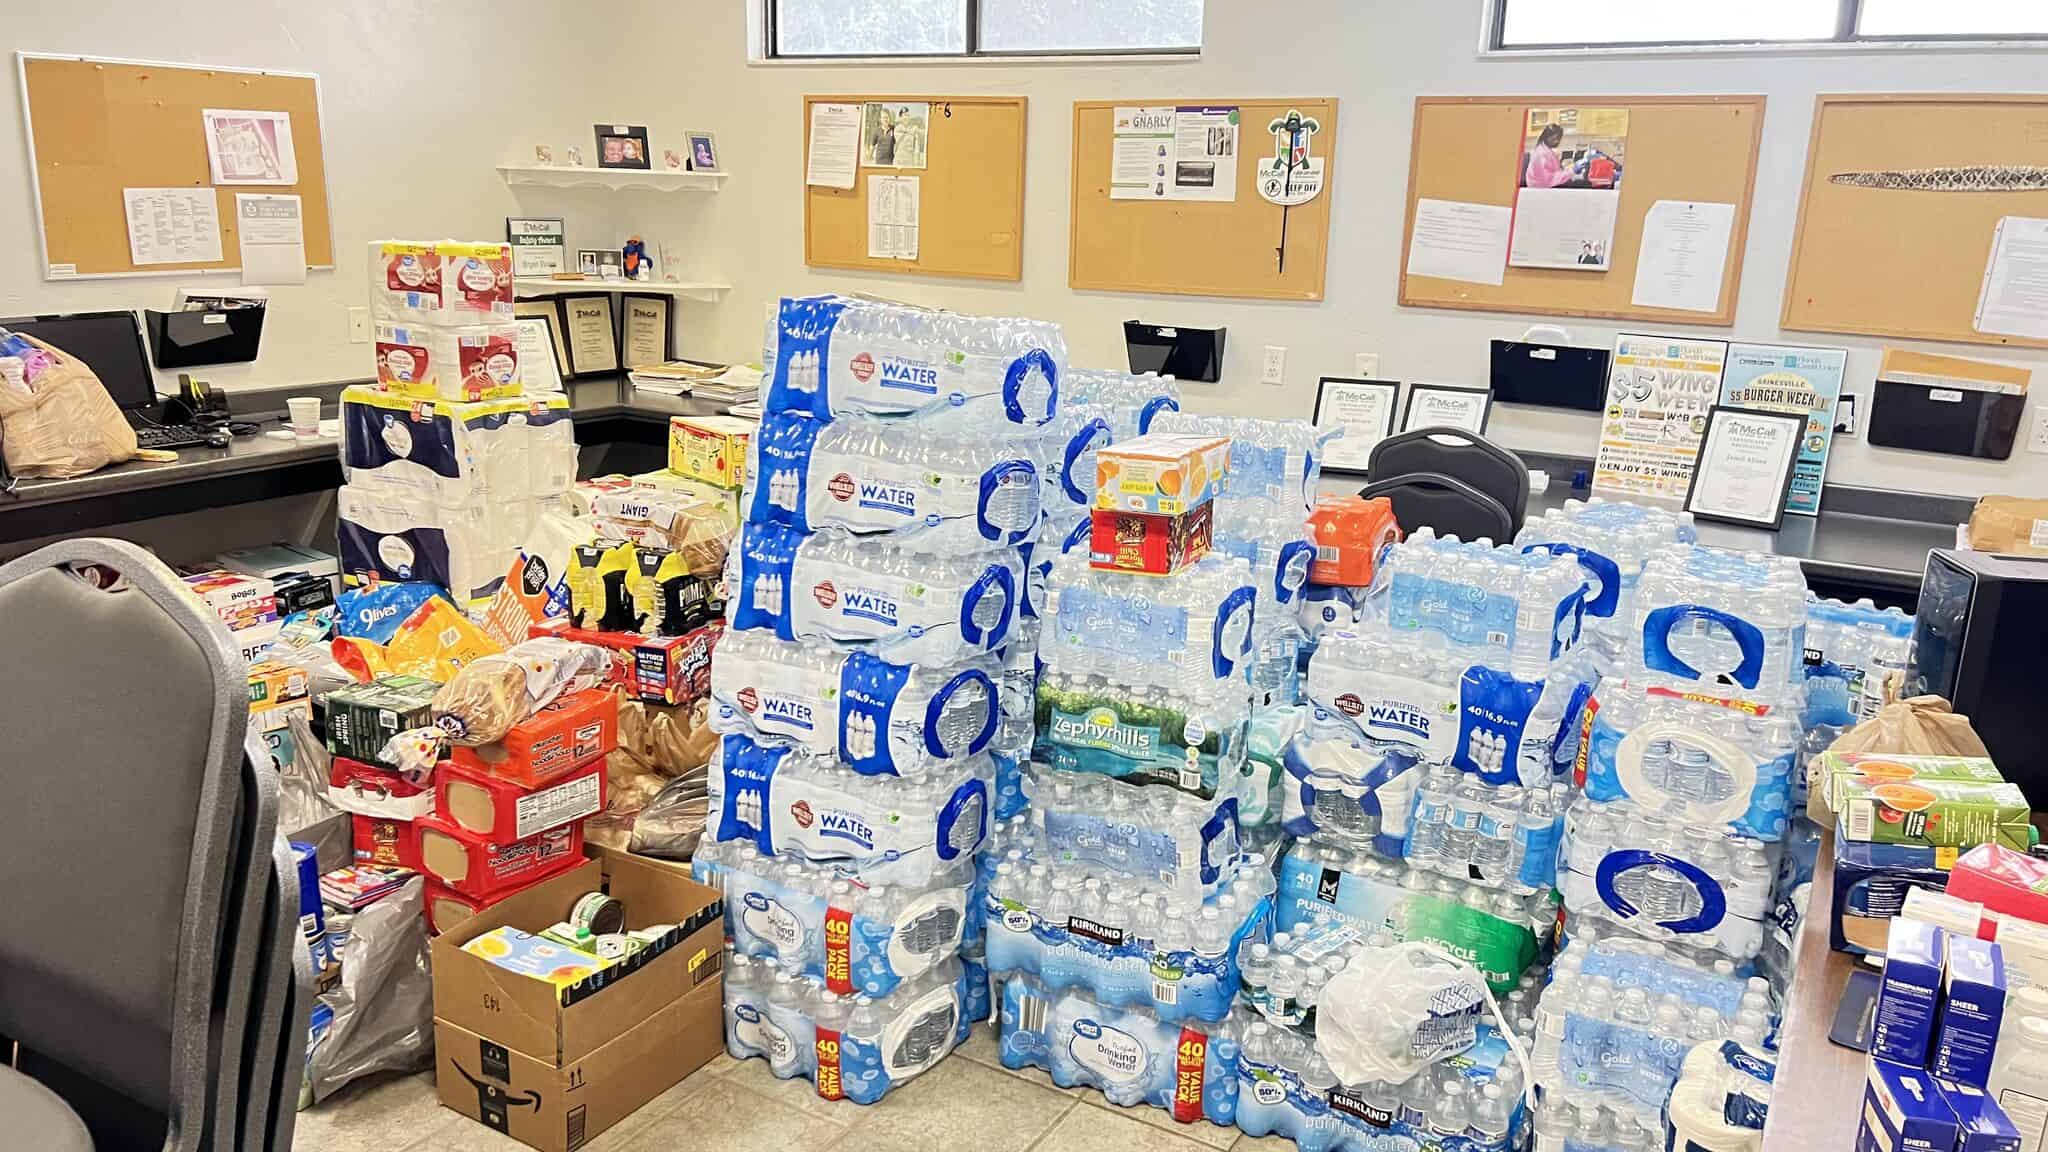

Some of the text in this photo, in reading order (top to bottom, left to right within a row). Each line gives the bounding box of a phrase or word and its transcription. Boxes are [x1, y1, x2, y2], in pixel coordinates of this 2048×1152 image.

[1133, 116, 1171, 128] GNARLY
[882, 362, 937, 385] WATER
[1659, 369, 1714, 394] WING
[1744, 389, 1783, 403] BURGER
[1786, 392, 1817, 406] WEEK
[1607, 463, 1640, 473] ENJOY
[861, 484, 915, 507] WATER
[620, 504, 649, 517] GIANT
[844, 592, 897, 617] WATER
[764, 697, 813, 721] WATER
[1369, 705, 1430, 731] WATER
[1382, 700, 1421, 713] PURIFIED
[1467, 705, 1482, 716] 40
[1485, 711, 1503, 724] 16.9
[1055, 717, 1149, 747] Zephyrhills
[731, 768, 745, 777] 40
[820, 814, 873, 841] WATER
[1295, 872, 1314, 884] 40
[1296, 898, 1345, 923] PURIFIED
[826, 919, 848, 935] 40
[1071, 917, 1121, 940] KIRKLAND
[827, 949, 837, 978] PACK
[837, 949, 848, 980] VALUE
[1950, 999, 1979, 1011] SHEER
[818, 1040, 838, 1054] 40
[1098, 1044, 1137, 1063] Drinking
[1180, 1040, 1204, 1057] 40
[1109, 1057, 1137, 1070] Water
[819, 1065, 829, 1095] PACK
[829, 1066, 840, 1096] VALUE
[1178, 1071, 1190, 1103] PACK
[1190, 1071, 1201, 1104] VALUE
[1258, 1087, 1282, 1097] 50%
[1333, 1094, 1389, 1122] KIRKLAND
[1903, 1137, 1930, 1148] SHEER
